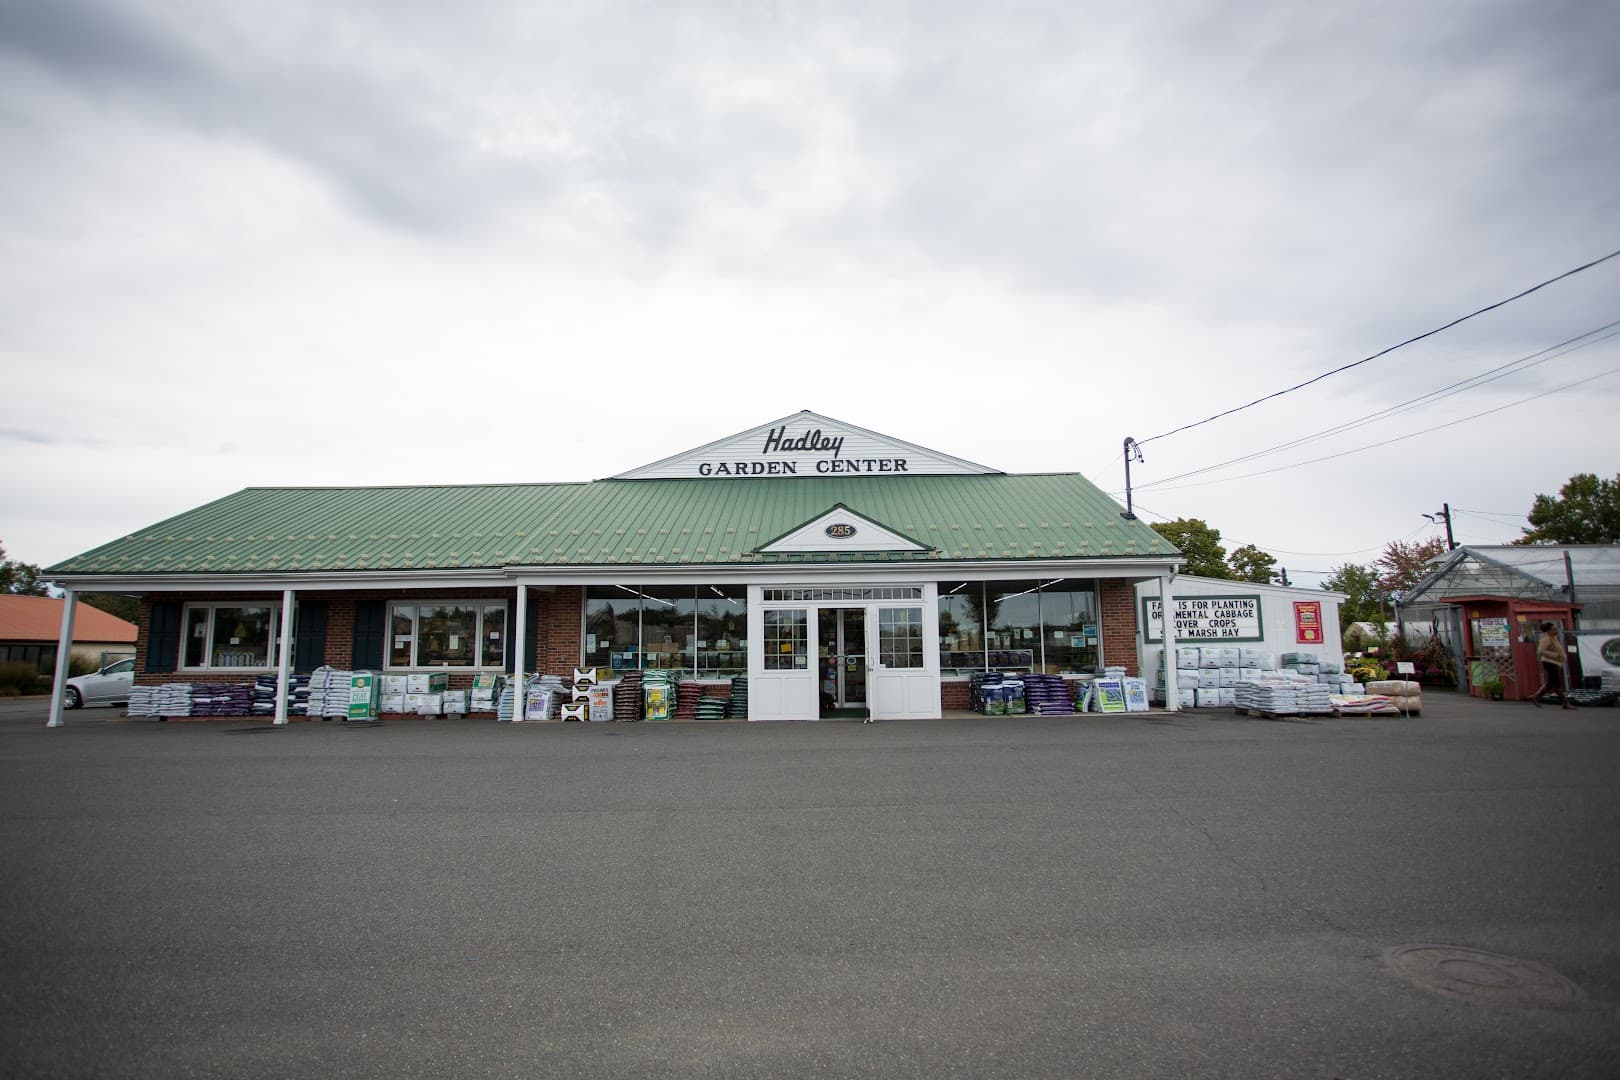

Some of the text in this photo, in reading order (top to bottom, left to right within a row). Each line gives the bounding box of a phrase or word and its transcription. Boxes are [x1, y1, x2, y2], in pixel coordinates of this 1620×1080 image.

[762, 425, 844, 458] Hadley
[699, 458, 908, 476] GARDEN CENTER
[830, 525, 851, 536] 285
[1178, 601, 1187, 609] IS
[1192, 601, 1208, 609] FOR
[1211, 600, 1254, 609] PLANTING
[1151, 609, 1254, 619] ORMENTAL CABBAGE
[1173, 619, 1236, 628] OVER CROPS
[1188, 629, 1218, 637] MARSH
[1222, 628, 1239, 637] HAY
